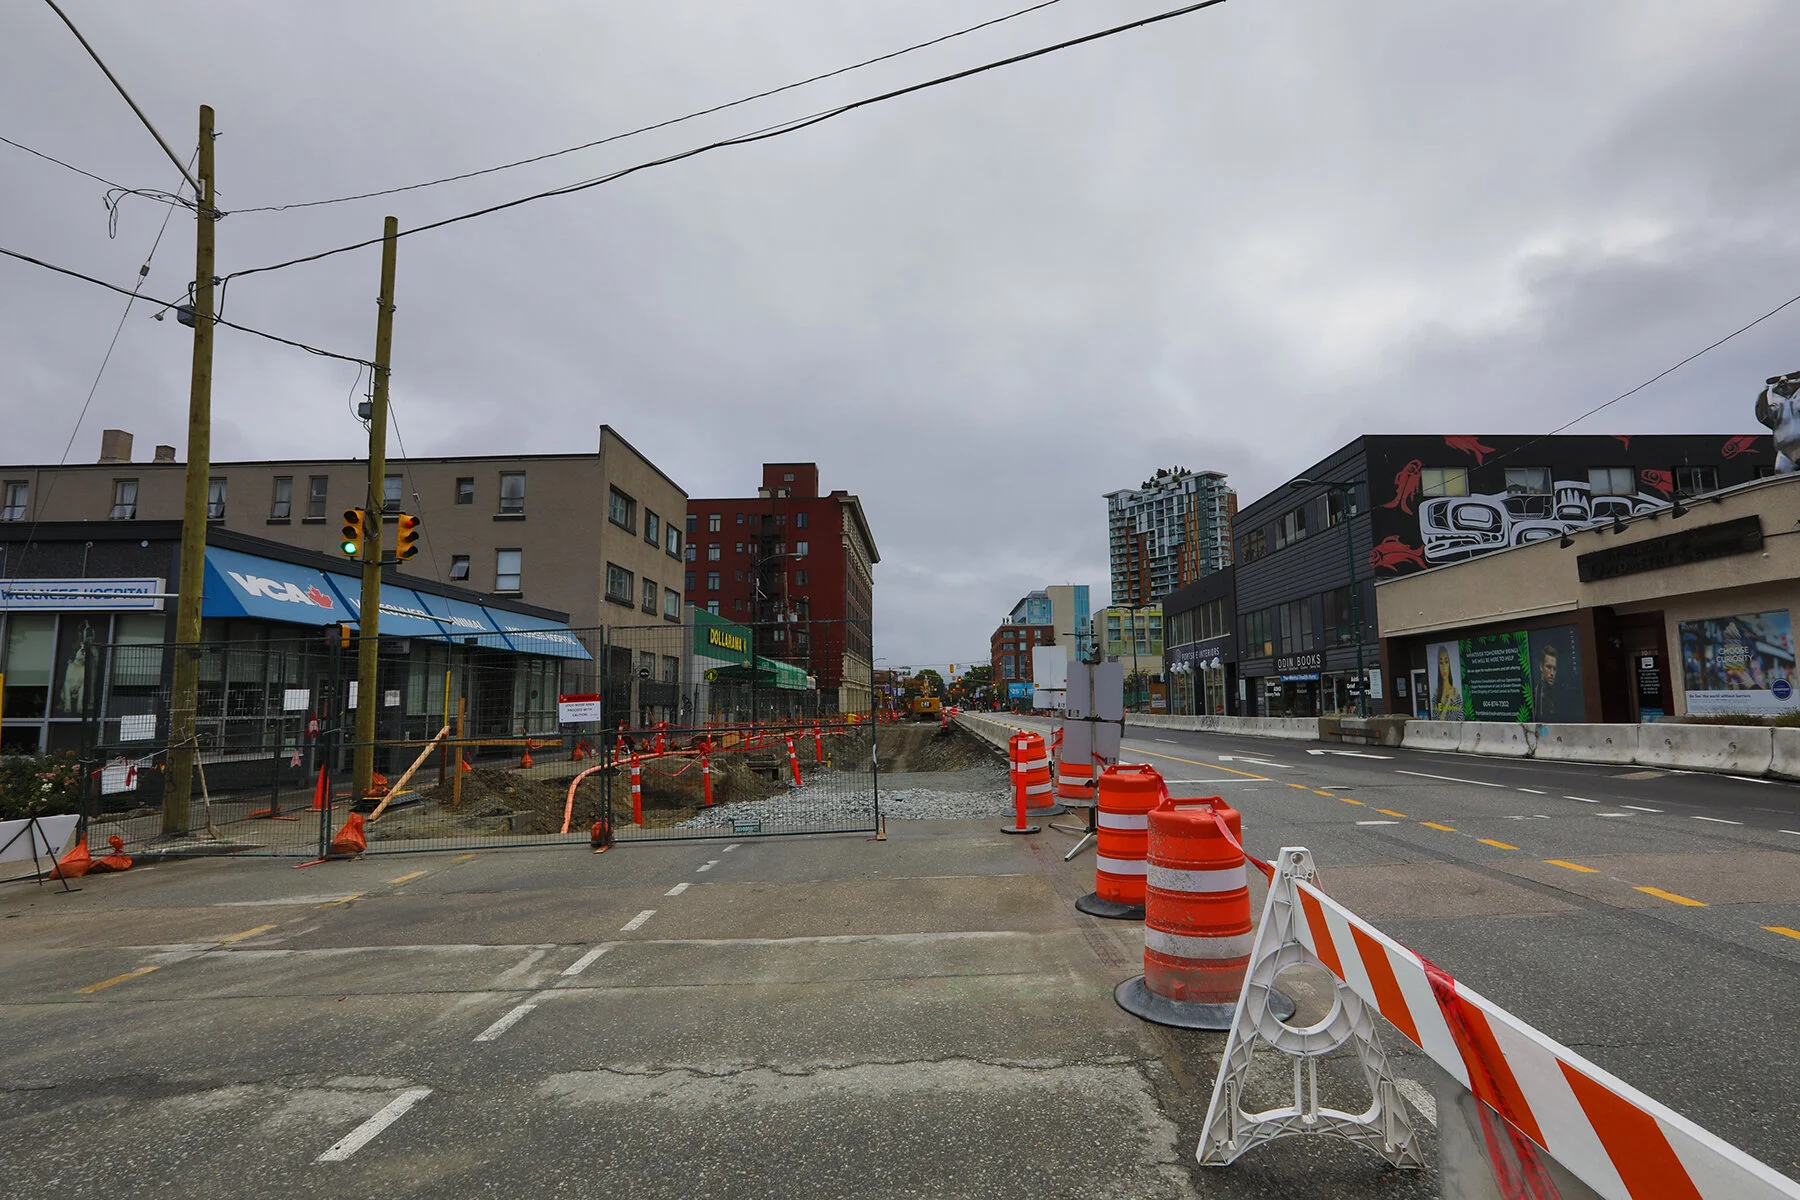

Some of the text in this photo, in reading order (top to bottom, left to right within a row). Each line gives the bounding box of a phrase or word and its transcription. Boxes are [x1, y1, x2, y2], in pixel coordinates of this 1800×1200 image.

[227, 570, 316, 606] VCA
[349, 598, 430, 621] VCOUVER
[710, 629, 742, 652] DOLLARAMA
[1716, 654, 1754, 664] CURIOSITY
[1719, 646, 1750, 656] CHOOSE
[1277, 657, 1294, 669] ODIN
[1297, 653, 1321, 666] BOOKS
